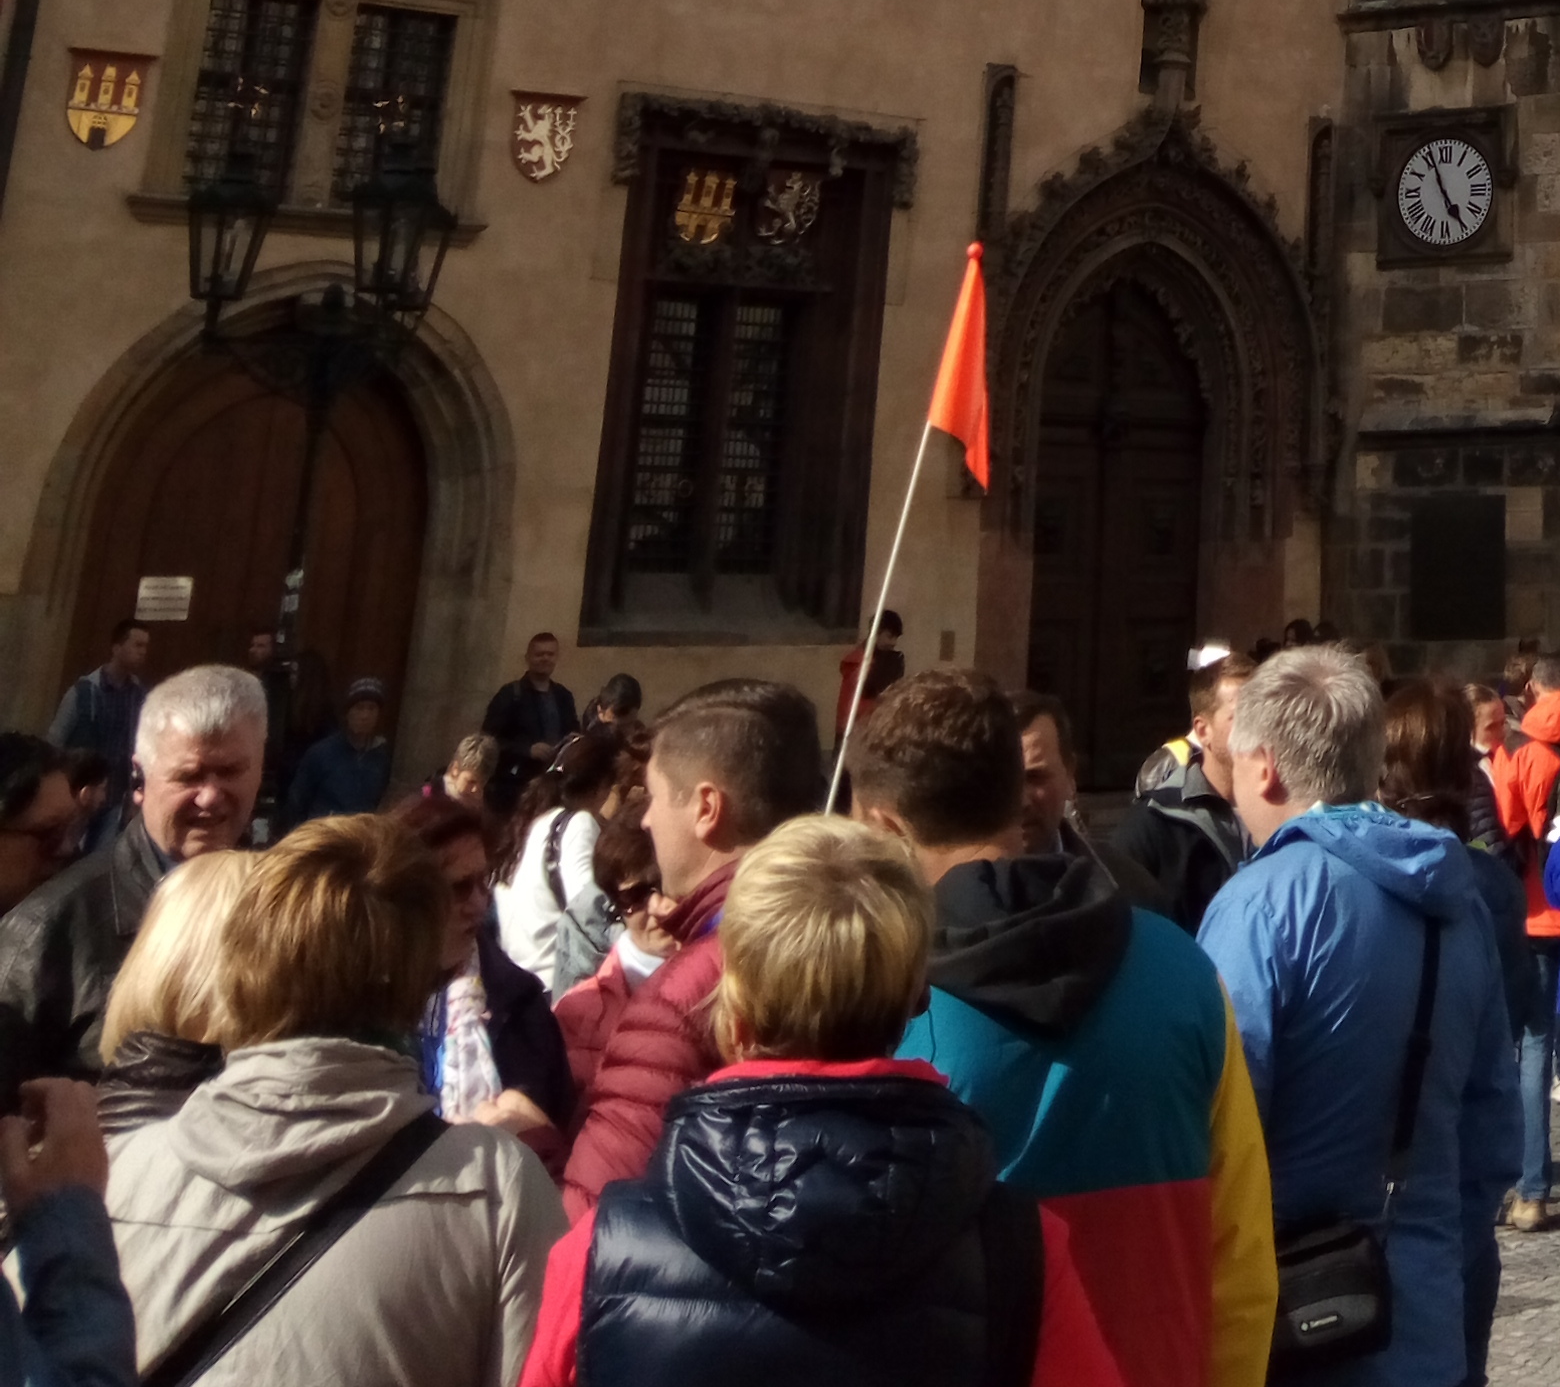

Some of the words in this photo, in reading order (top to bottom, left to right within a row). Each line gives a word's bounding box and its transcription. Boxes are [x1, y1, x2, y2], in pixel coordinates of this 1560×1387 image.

[1439, 146, 1452, 164] XII
[1466, 164, 1482, 179] II
[1470, 183, 1486, 196] III
